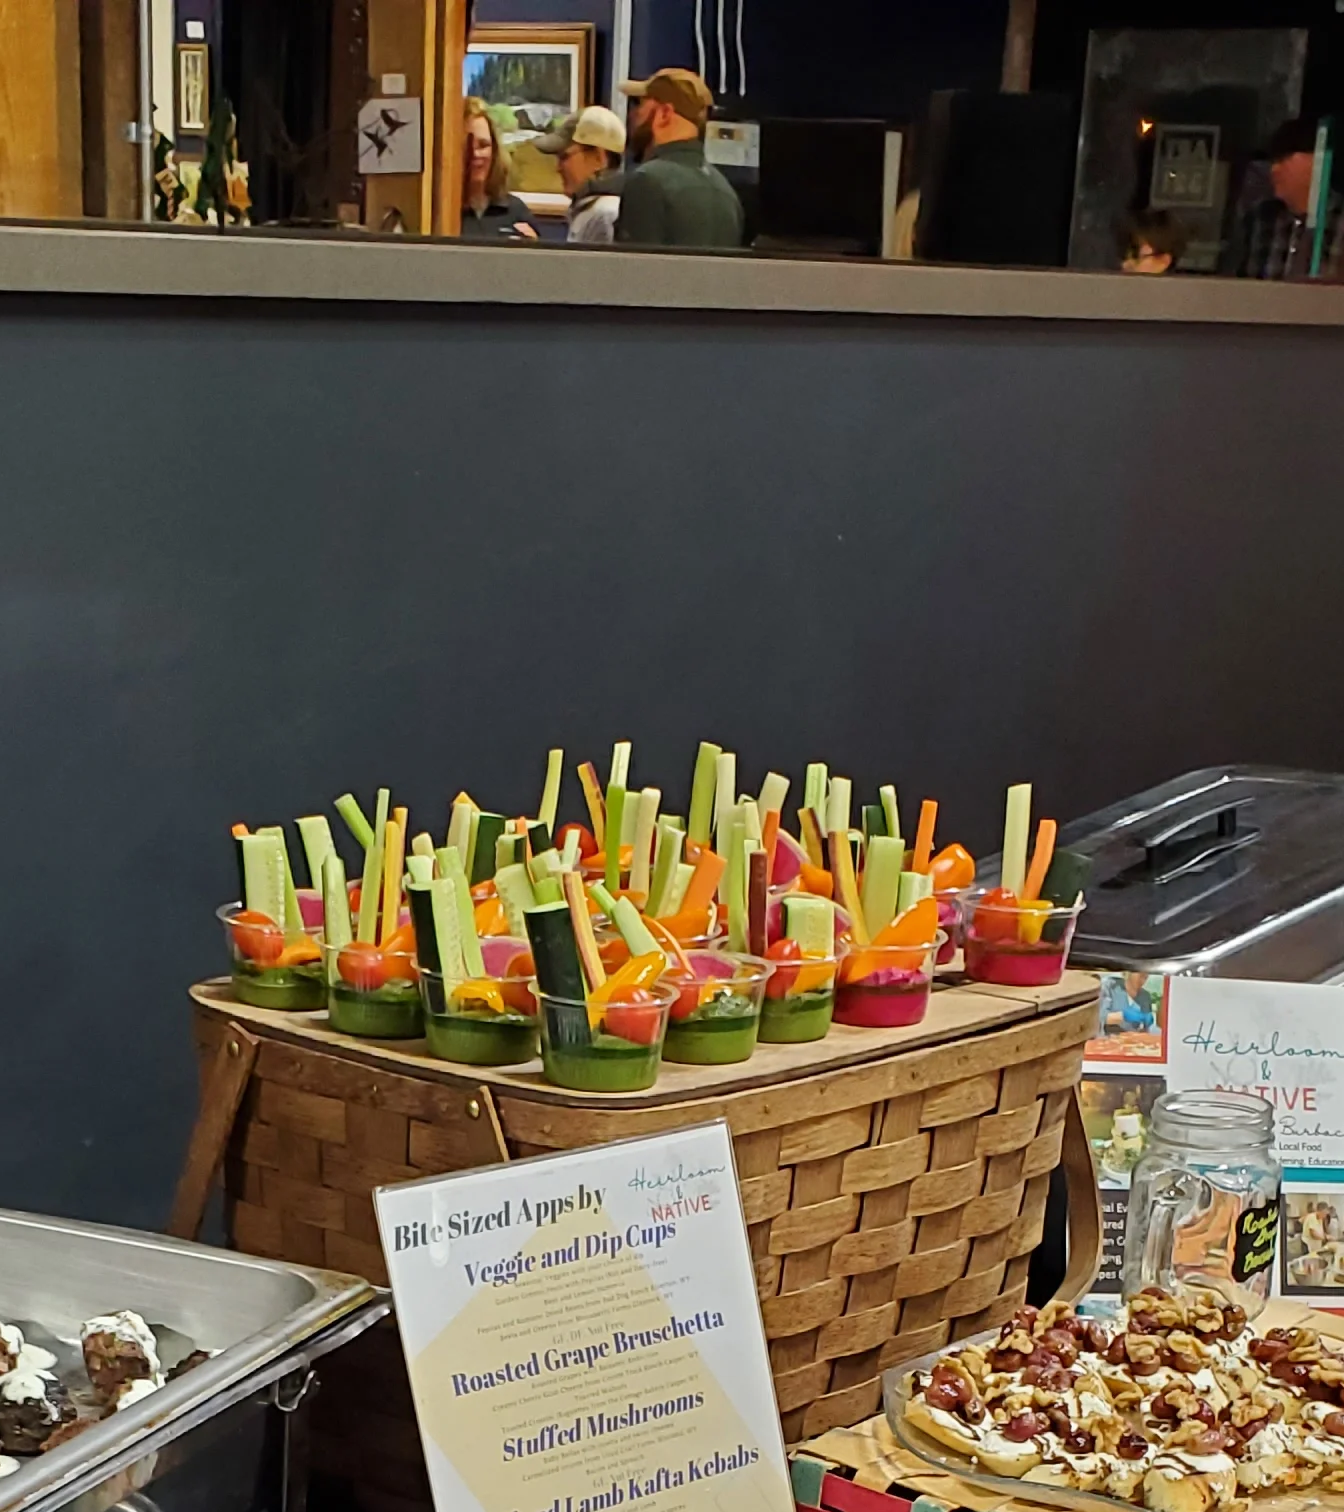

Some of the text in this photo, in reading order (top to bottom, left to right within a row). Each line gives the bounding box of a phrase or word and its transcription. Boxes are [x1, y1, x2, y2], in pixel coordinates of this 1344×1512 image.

[1215, 1084, 1318, 1112] TIVE
[1279, 1141, 1322, 1152] Local Food
[627, 1163, 725, 1189] Heirloom
[394, 1183, 605, 1251] Bite Sized Apps by
[650, 1193, 712, 1223] NATIVE
[464, 1217, 675, 1287] Veggie and Dip Cups
[452, 1352, 539, 1396] Roasted
[543, 1342, 609, 1371] Grape
[613, 1311, 723, 1353] Bruschetta
[503, 1417, 581, 1461] Stuffed
[587, 1392, 703, 1436] Mushrooms
[628, 1467, 683, 1500] Kafta
[688, 1444, 758, 1482] Kebabs
